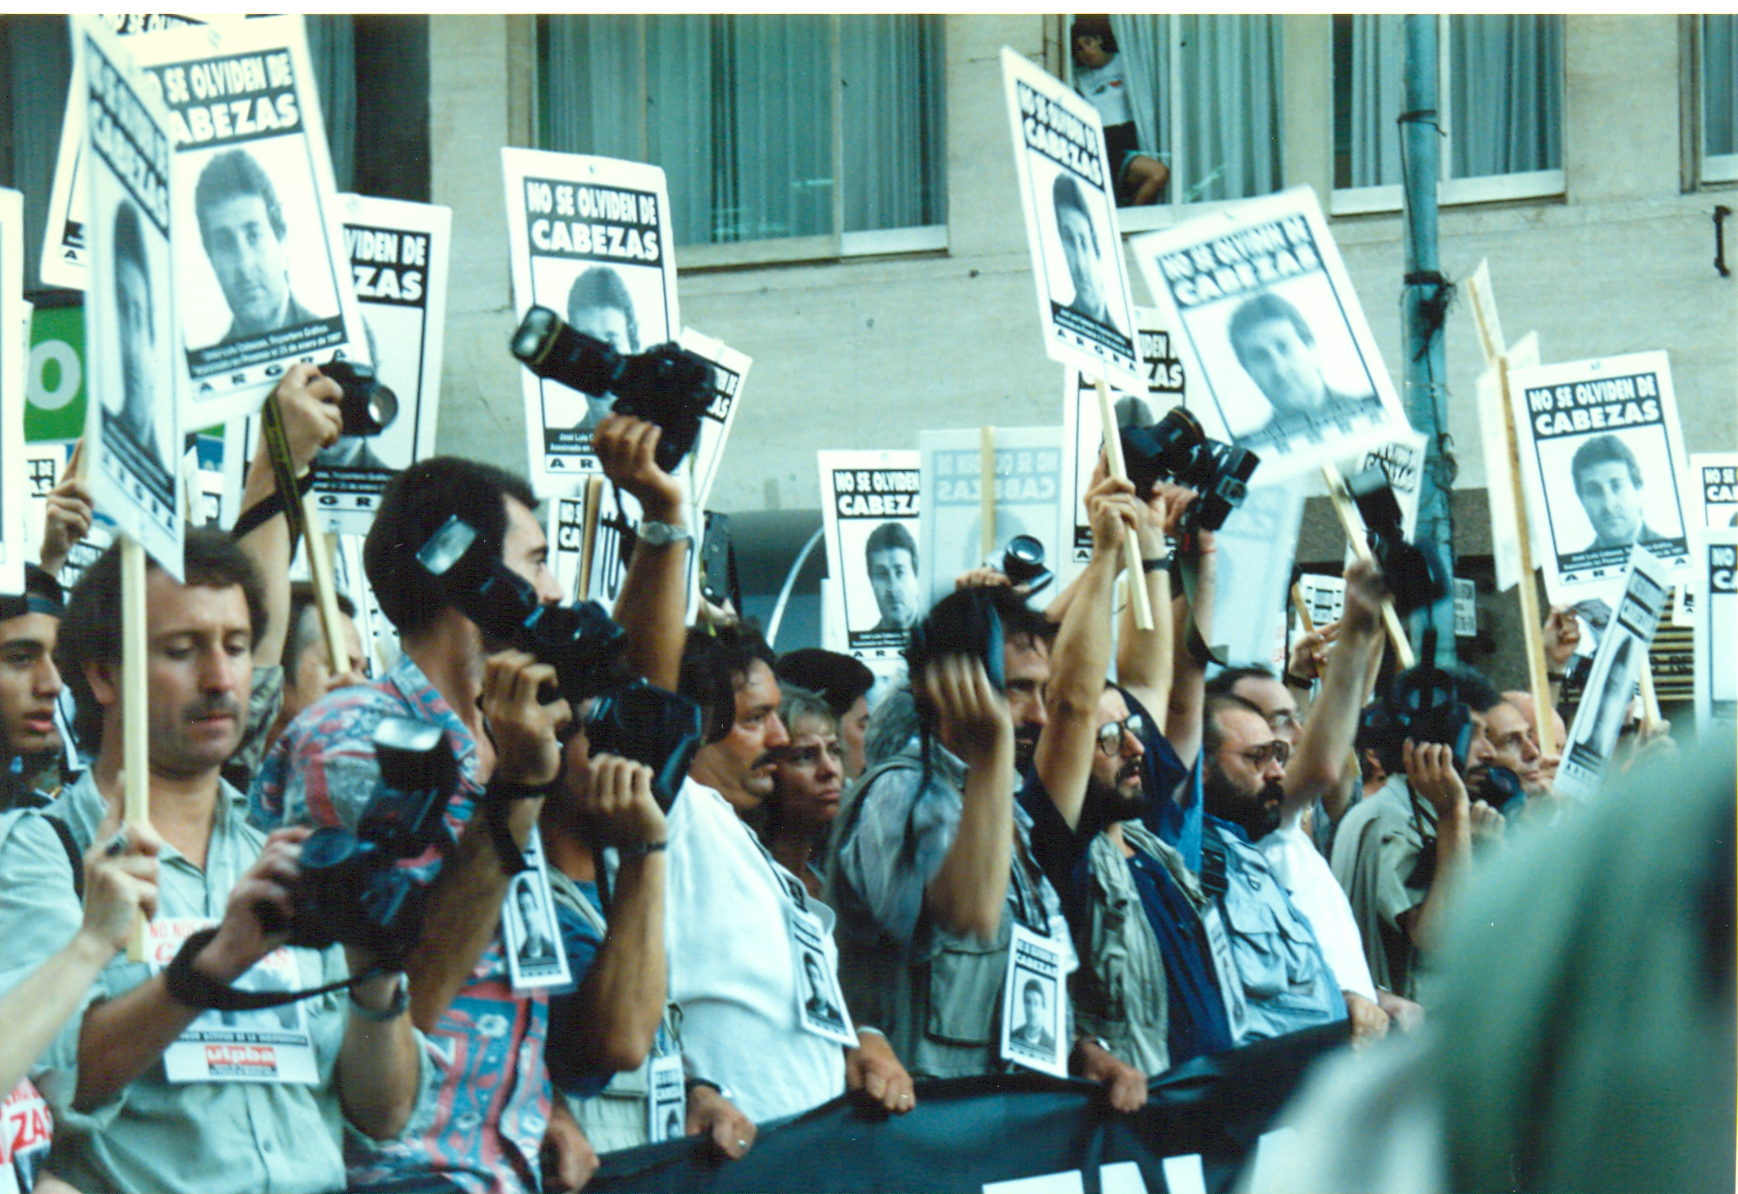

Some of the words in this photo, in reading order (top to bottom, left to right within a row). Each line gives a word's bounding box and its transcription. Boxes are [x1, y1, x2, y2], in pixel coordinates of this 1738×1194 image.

[164, 66, 191, 104] SE
[190, 55, 267, 100] OLVIDEN
[265, 52, 293, 89] DE
[168, 93, 300, 146] ABEZAS
[1024, 116, 1103, 187] CABEZAS
[526, 180, 553, 213] NO
[555, 184, 575, 217] SE
[577, 186, 637, 224] OLVIDEN
[638, 194, 657, 226] DE
[344, 227, 398, 264] VIDEN
[402, 234, 426, 267] DE
[531, 218, 660, 262] CABEZAS
[353, 265, 423, 301] ZAS
[1529, 388, 1554, 412] NO
[1555, 385, 1575, 409] SE
[1575, 377, 1636, 406] OLVIDEN
[1636, 374, 1657, 398] DE
[1535, 399, 1660, 436] CABEZAS
[835, 470, 855, 493] NO
[855, 470, 872, 493] SE
